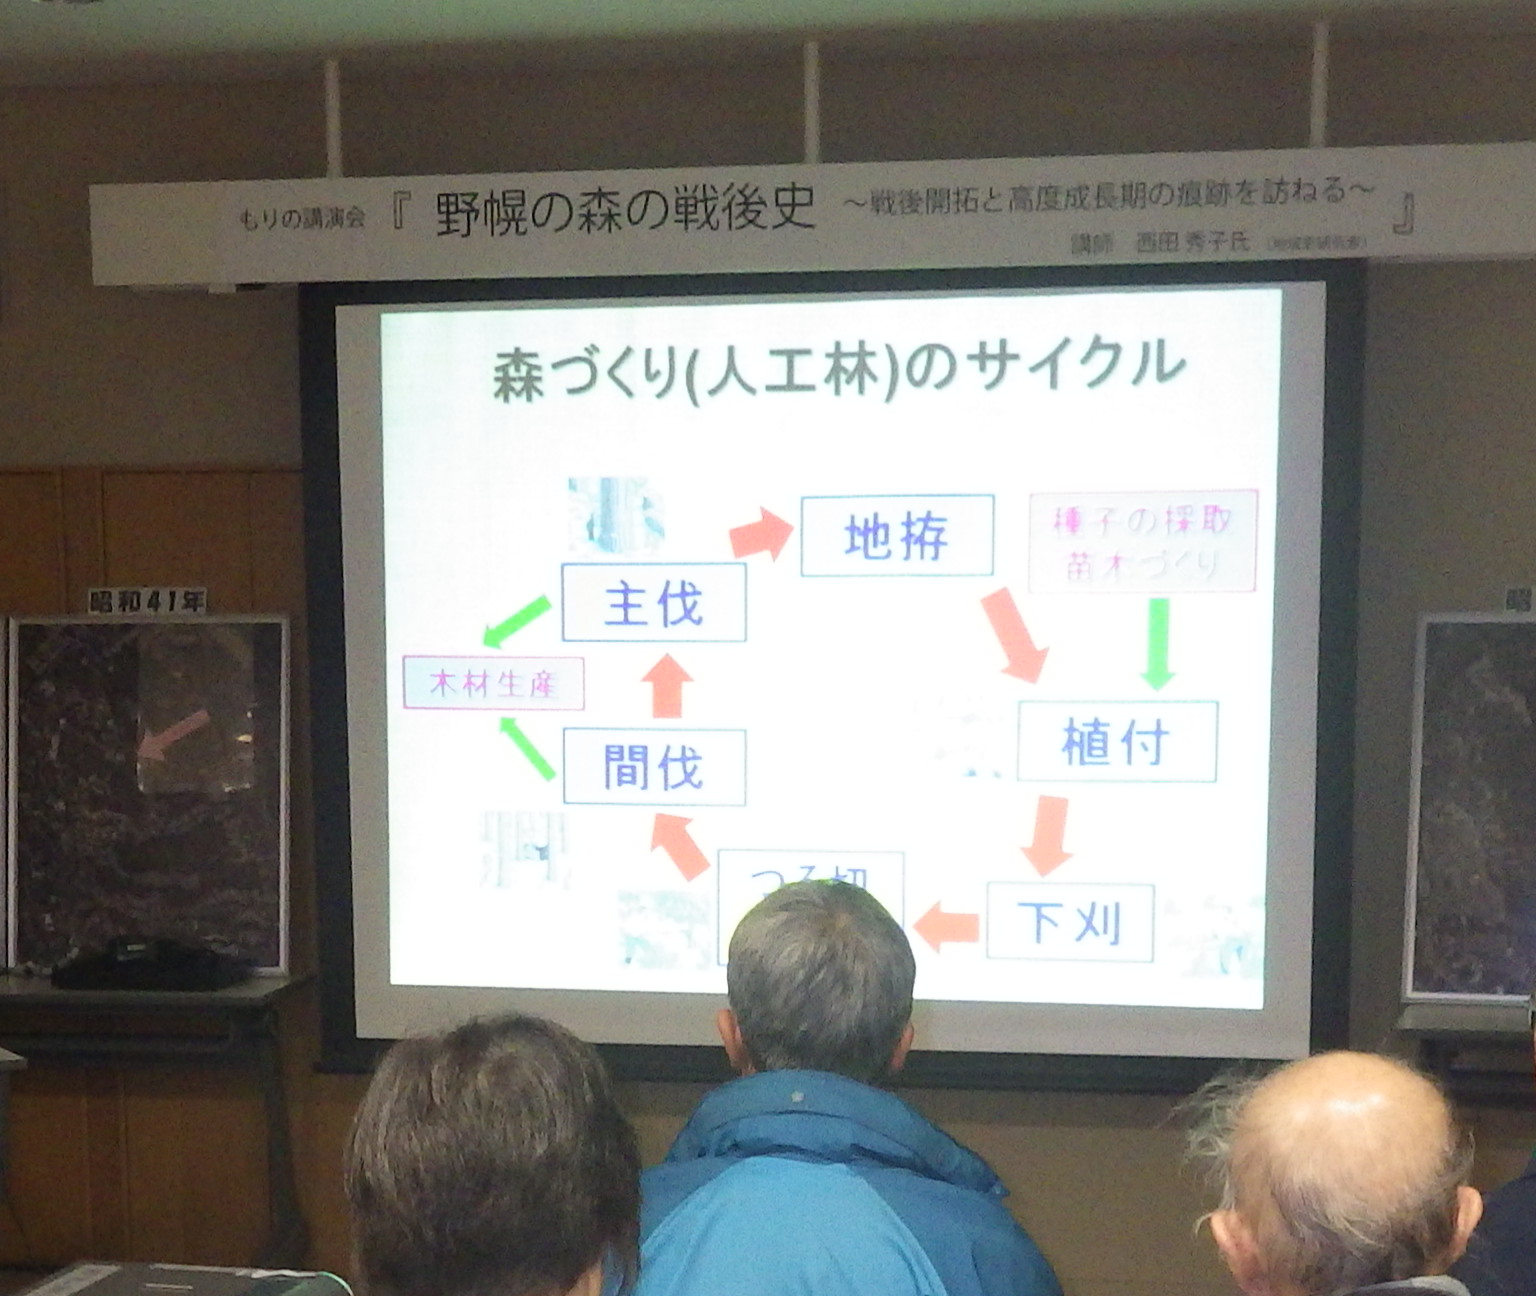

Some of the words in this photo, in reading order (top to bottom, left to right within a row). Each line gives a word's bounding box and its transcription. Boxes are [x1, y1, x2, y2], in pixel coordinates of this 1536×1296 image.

[240, 206, 364, 231] もりの講演会
[492, 333, 1187, 408] 森づくり(人工林)のサイクル
[1054, 505, 1231, 538] 種子の採取
[1067, 551, 1217, 582] 苗木づくり
[91, 589, 205, 612] 昭和41年
[604, 580, 703, 628] 主伐
[429, 668, 559, 698] 木材生産
[1061, 717, 1170, 766] 植付
[604, 744, 703, 791] 間伐
[1018, 902, 1120, 946] 下刈
